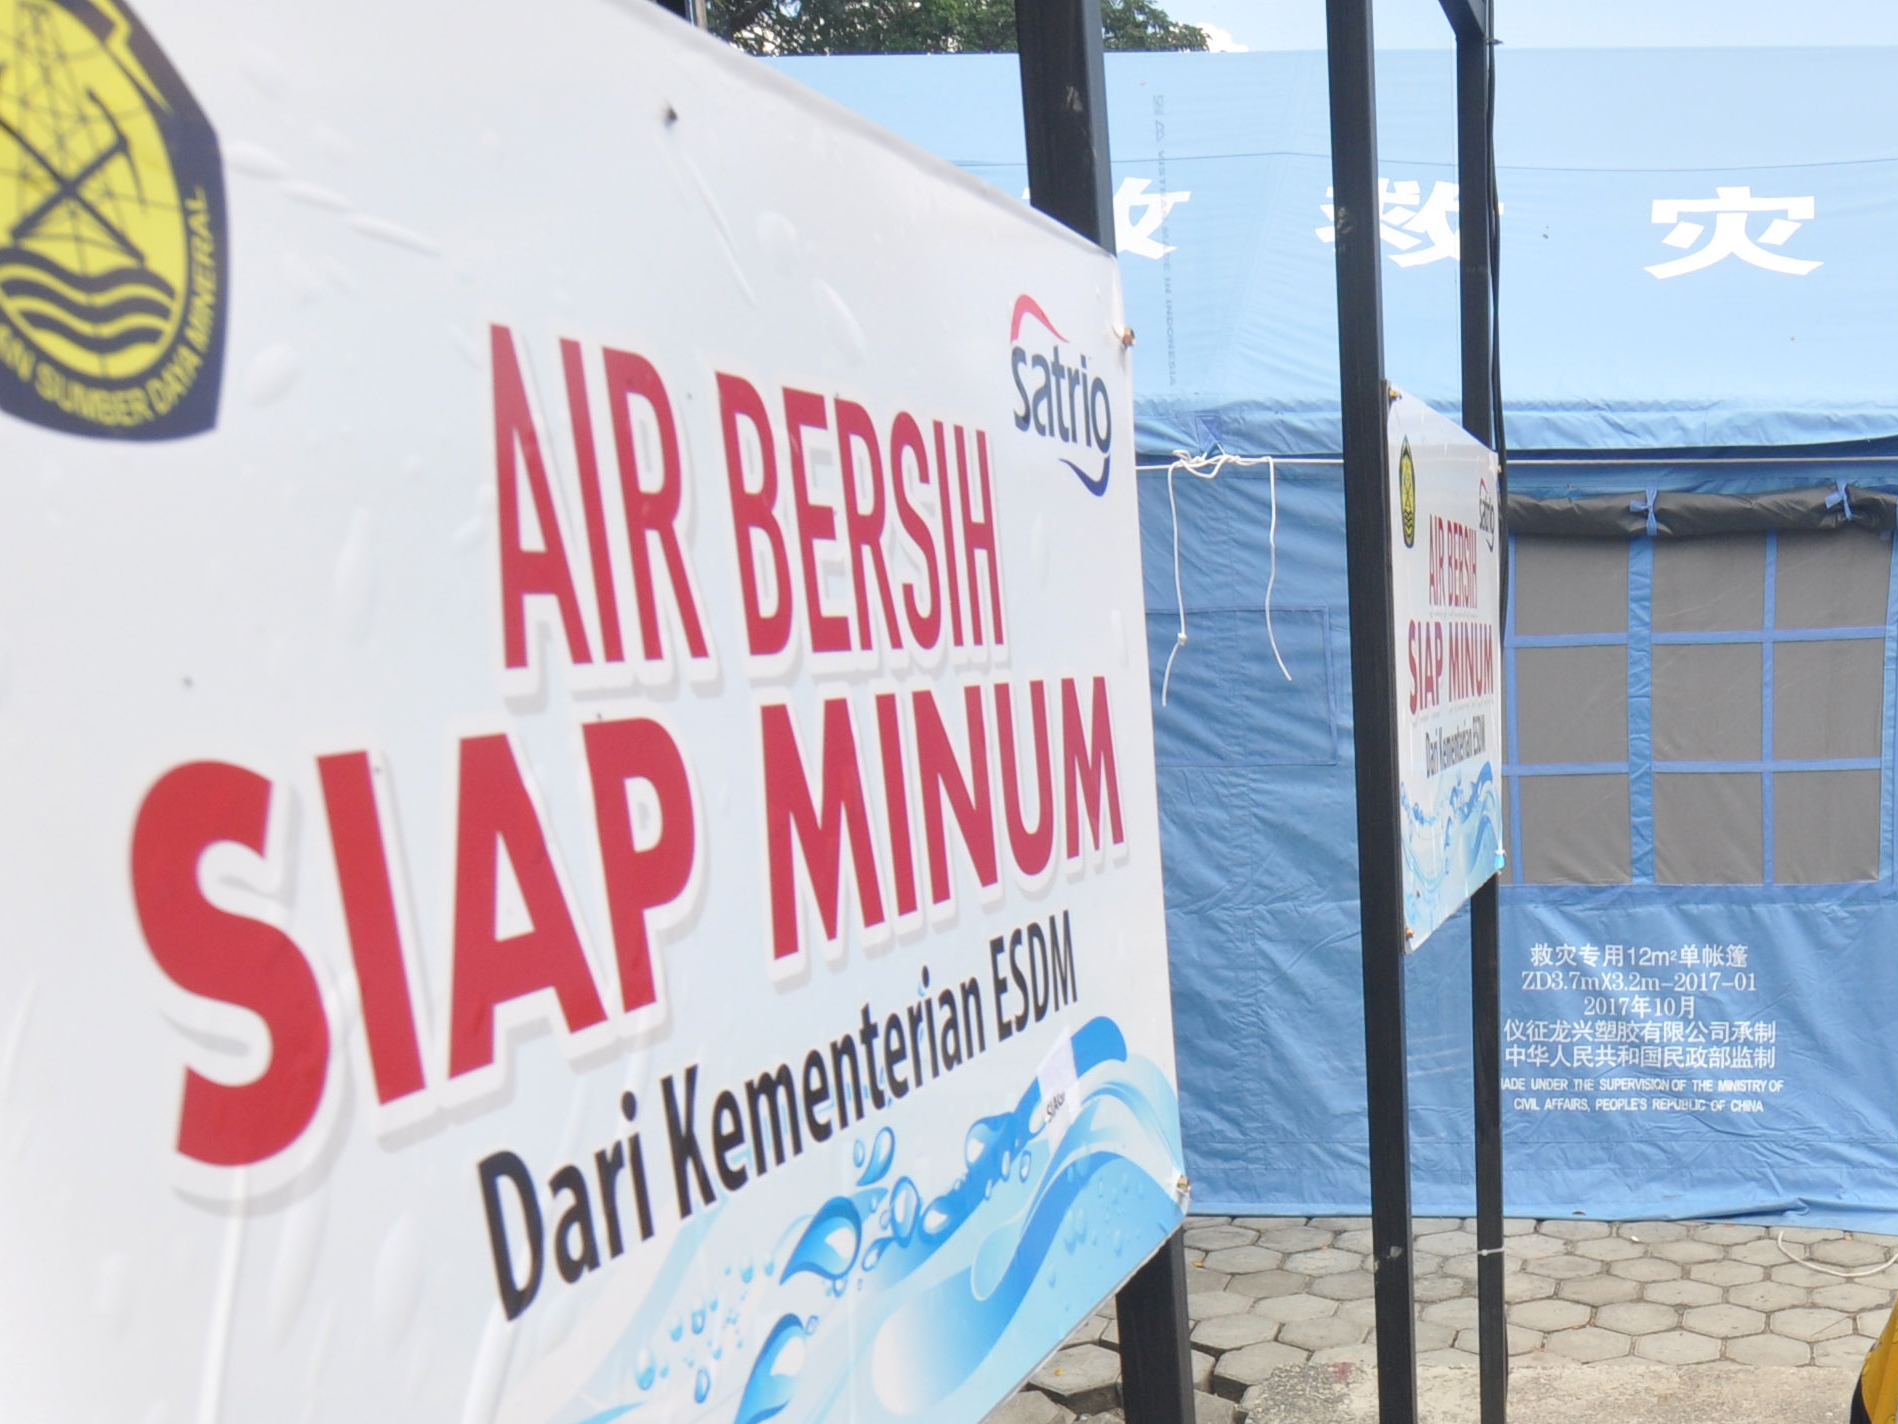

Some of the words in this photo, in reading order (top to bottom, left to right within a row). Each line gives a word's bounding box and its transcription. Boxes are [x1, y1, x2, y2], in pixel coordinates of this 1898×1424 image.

[1011, 344, 1112, 453] satrio
[490, 323, 710, 670] AIR
[714, 370, 1005, 658] BERSIH
[1429, 513, 1445, 606] AIR
[1447, 519, 1478, 609] BERSIH
[1408, 619, 1444, 715] SIAP
[1448, 621, 1494, 703] MINUM
[1425, 727, 1438, 778] Dari
[1438, 719, 1473, 772] Kementerian
[129, 716, 696, 1168] SIAP
[760, 676, 1124, 961] MINUM
[1583, 994, 1696, 1019] 2017年10月
[1505, 1045, 1777, 1069] 中华人民共和国民政部监制
[1531, 1078, 1569, 1092] UNDER
[1574, 1078, 1595, 1092] THE
[1599, 1078, 1669, 1092] SUPERVISION
[1671, 1079, 1687, 1092] OF
[1692, 1079, 1713, 1093] THE
[1717, 1079, 1766, 1093] MINISTRY
[1769, 1079, 1785, 1093] OF
[477, 1093, 655, 1322] Dari
[661, 967, 987, 1215] Kementerian
[991, 909, 1078, 1043] ESDM
[1513, 1098, 1540, 1111] CIVIL
[1652, 1099, 1705, 1112] REPUBLIC
[1710, 1099, 1726, 1112] OF
[1730, 1099, 1764, 1113] CHINA
